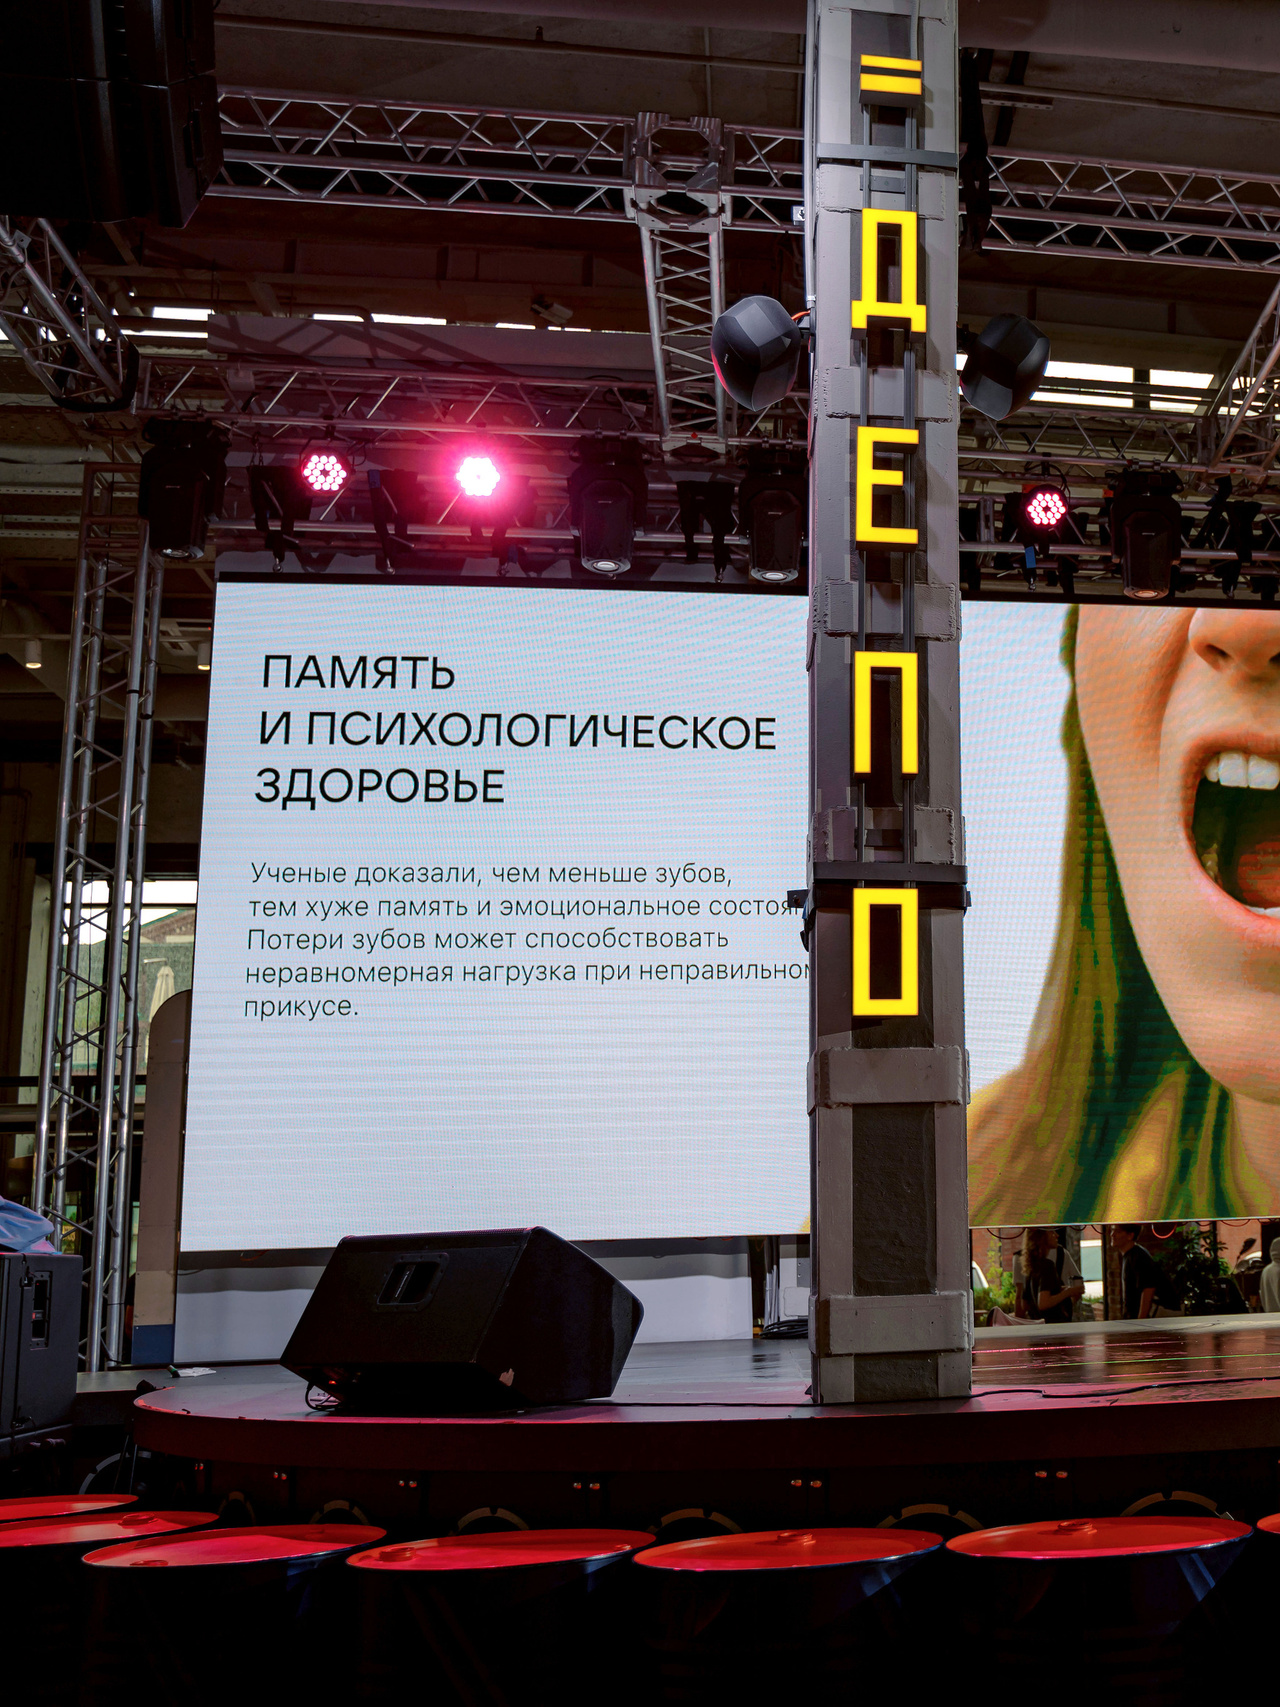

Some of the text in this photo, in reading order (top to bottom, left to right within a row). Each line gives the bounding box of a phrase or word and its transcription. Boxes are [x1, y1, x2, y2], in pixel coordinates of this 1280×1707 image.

[852, 208, 927, 1016] ДЕПО
[262, 655, 456, 690] ПАМЯТЬ
[259, 711, 777, 750] И ПСИХОЛОГИЧЕСКОЕ
[254, 767, 506, 811] ЗДОРОВЬЕ
[250, 862, 732, 888] Ученые доказали, чем меньше зубов,
[248, 898, 799, 922] тем хуже память и эмоциональное состоя
[247, 927, 729, 955] Потери зубов может способствовать
[246, 964, 453, 988] неравномерная
[463, 964, 576, 986] нагрузка
[585, 964, 630, 986] при
[244, 999, 359, 1022] прикусе.
